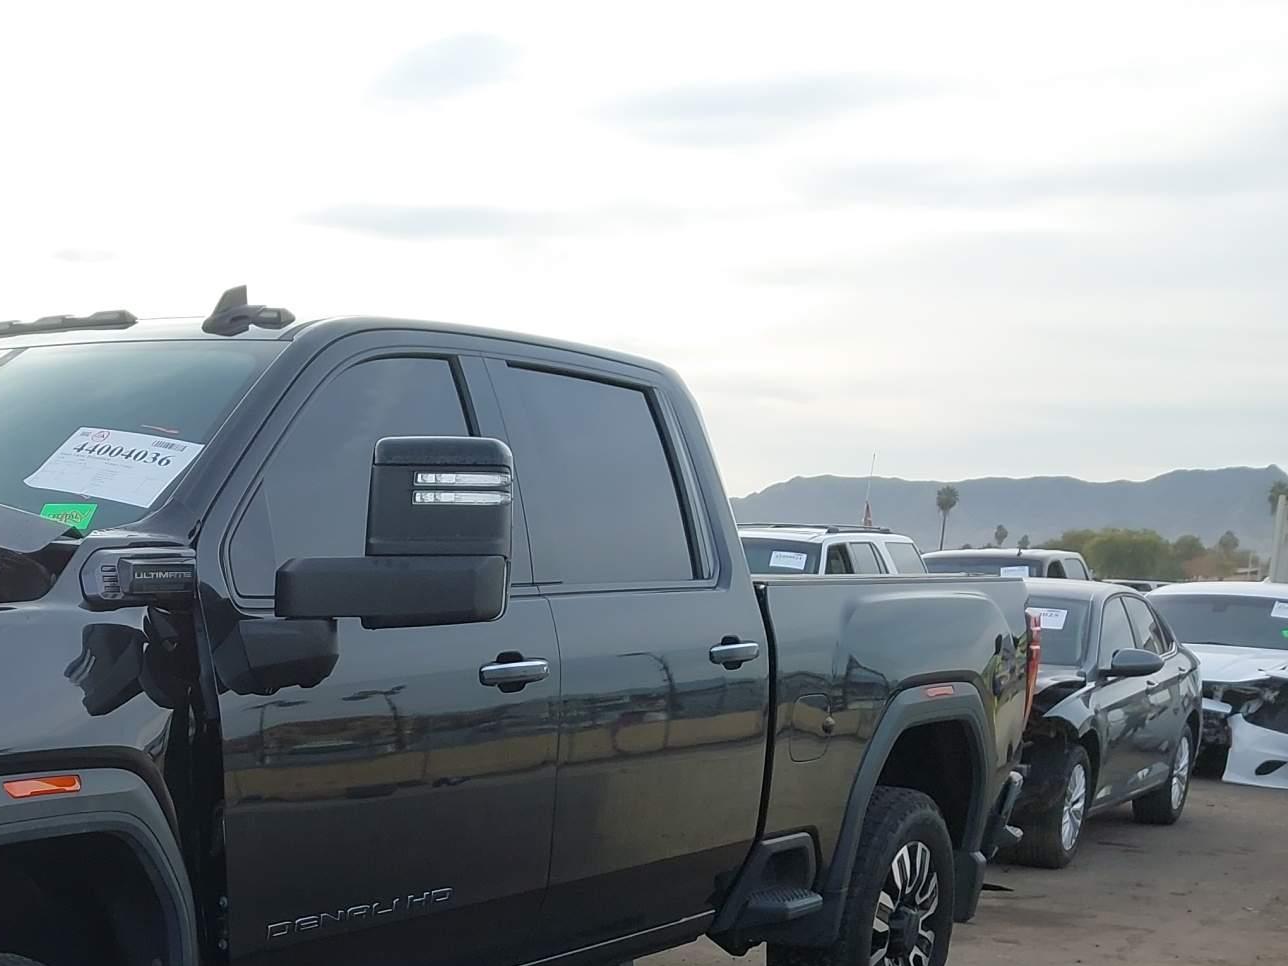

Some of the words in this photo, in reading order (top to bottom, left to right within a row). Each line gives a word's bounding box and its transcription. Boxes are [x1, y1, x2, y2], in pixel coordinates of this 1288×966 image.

[73, 442, 175, 467] 44004036
[134, 571, 193, 579] ULTIMATE
[266, 898, 400, 941] DENALI
[406, 887, 454, 911] HD
